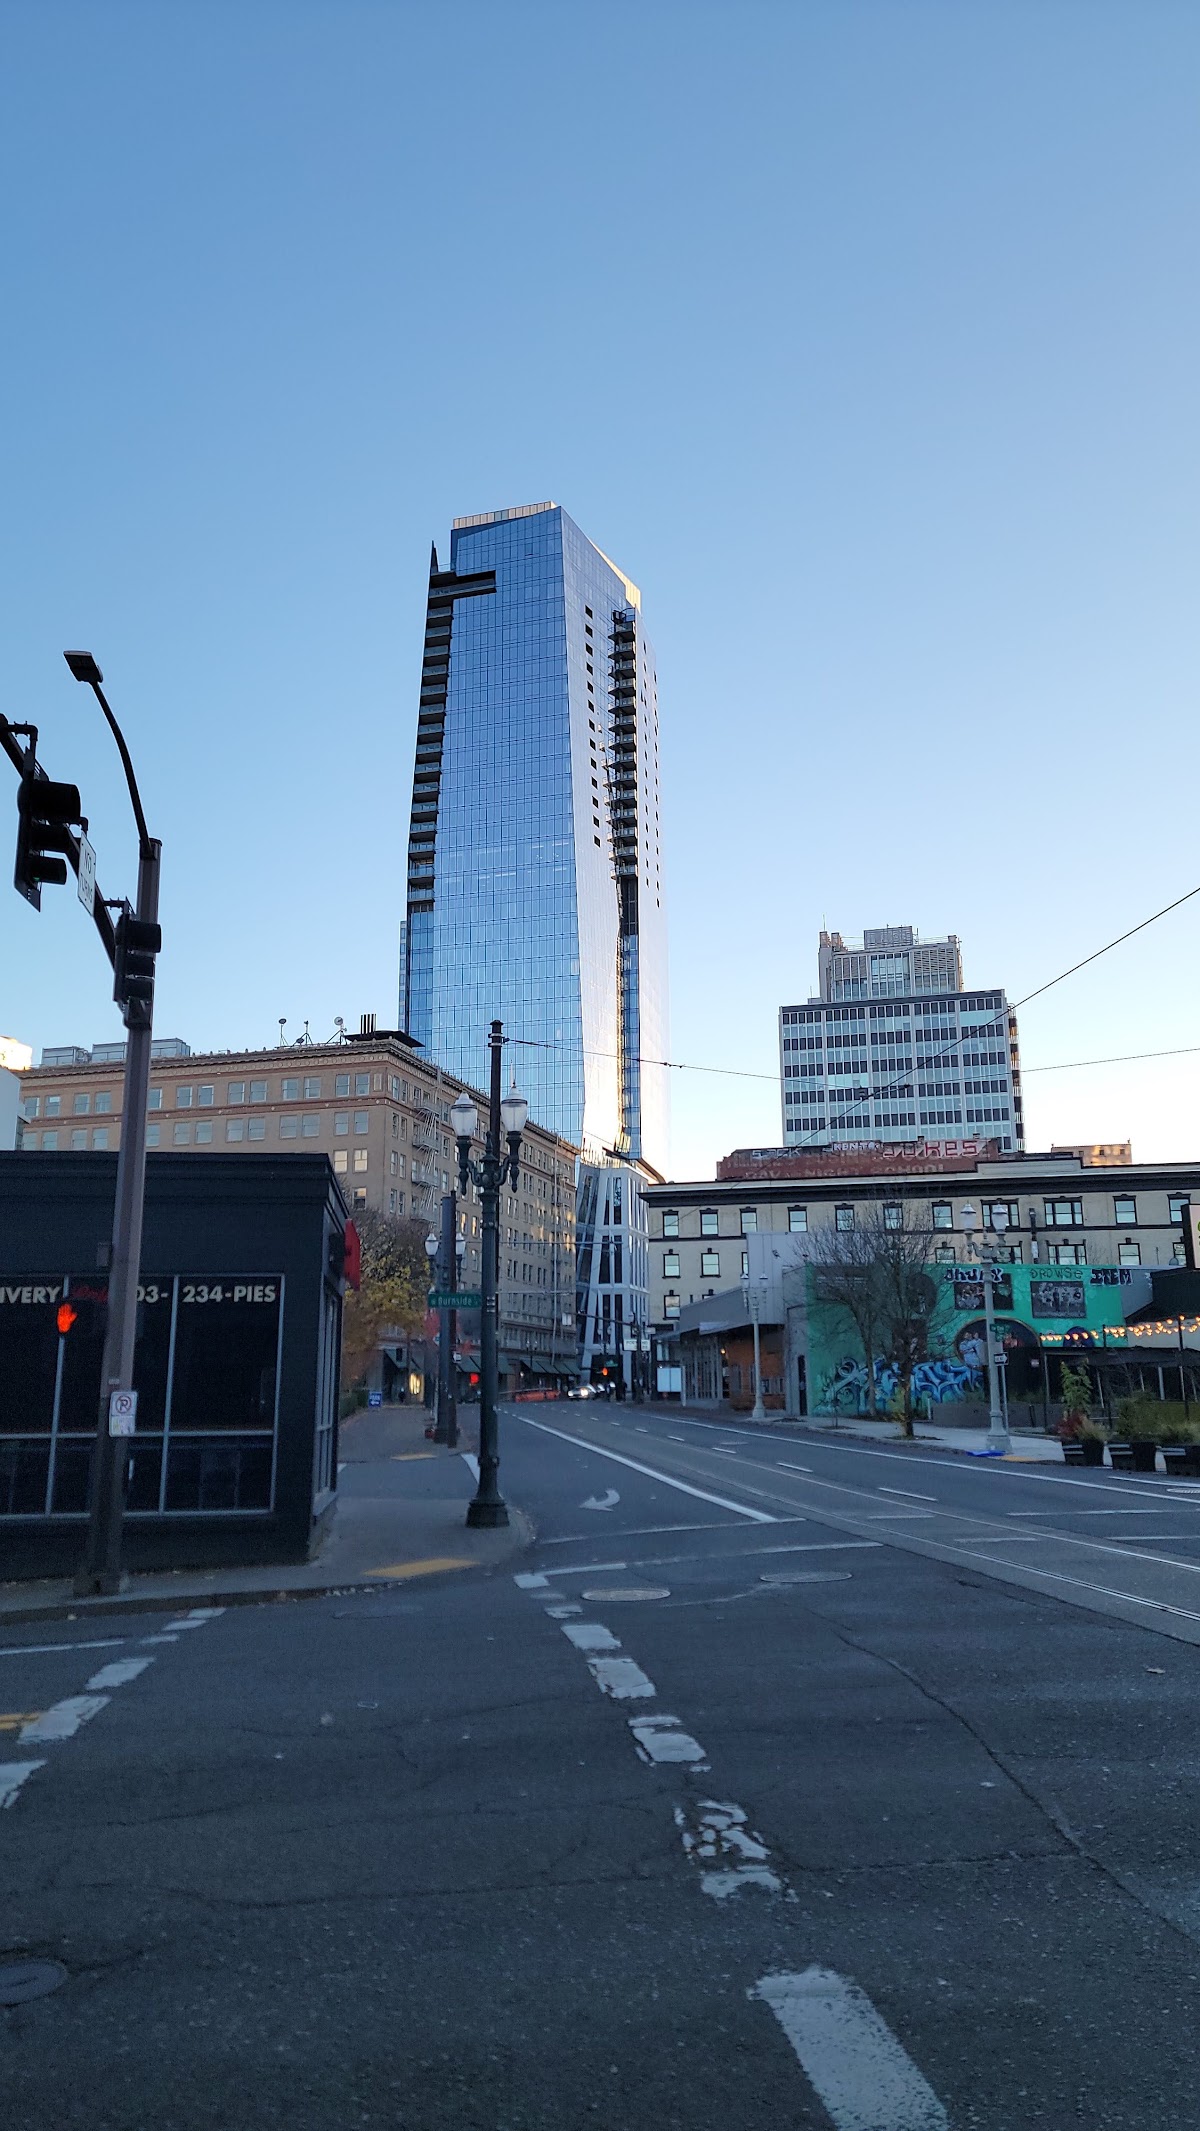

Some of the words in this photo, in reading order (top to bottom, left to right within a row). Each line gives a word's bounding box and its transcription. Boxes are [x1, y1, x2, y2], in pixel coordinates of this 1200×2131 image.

[84, 849, 92, 874] NO
[80, 873, 92, 902] TURNS
[182, 1285, 276, 1303] 234-PIES
[437, 1296, 472, 1306] Burnside
